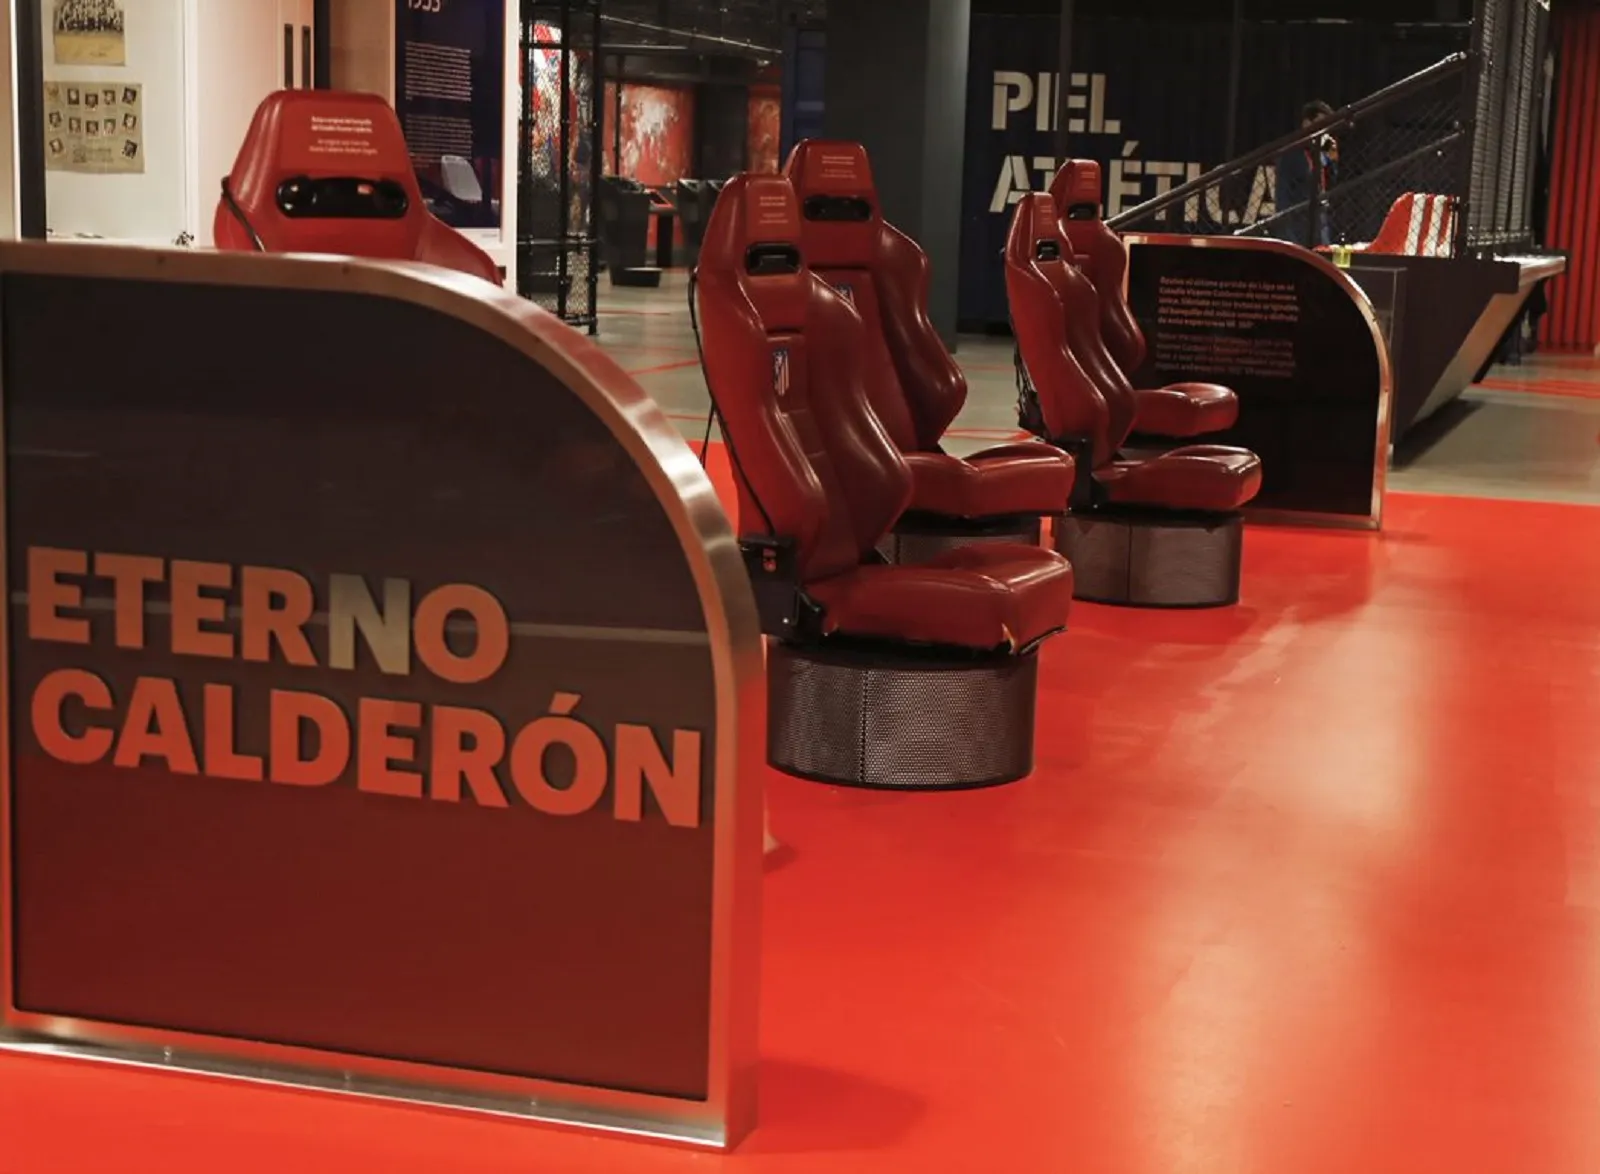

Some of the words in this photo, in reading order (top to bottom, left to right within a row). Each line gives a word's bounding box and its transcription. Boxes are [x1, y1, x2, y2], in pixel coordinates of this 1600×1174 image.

[991, 71, 1121, 134] PIEL
[27, 546, 510, 684] ETERNO
[31, 668, 702, 828] CALDERÓN
